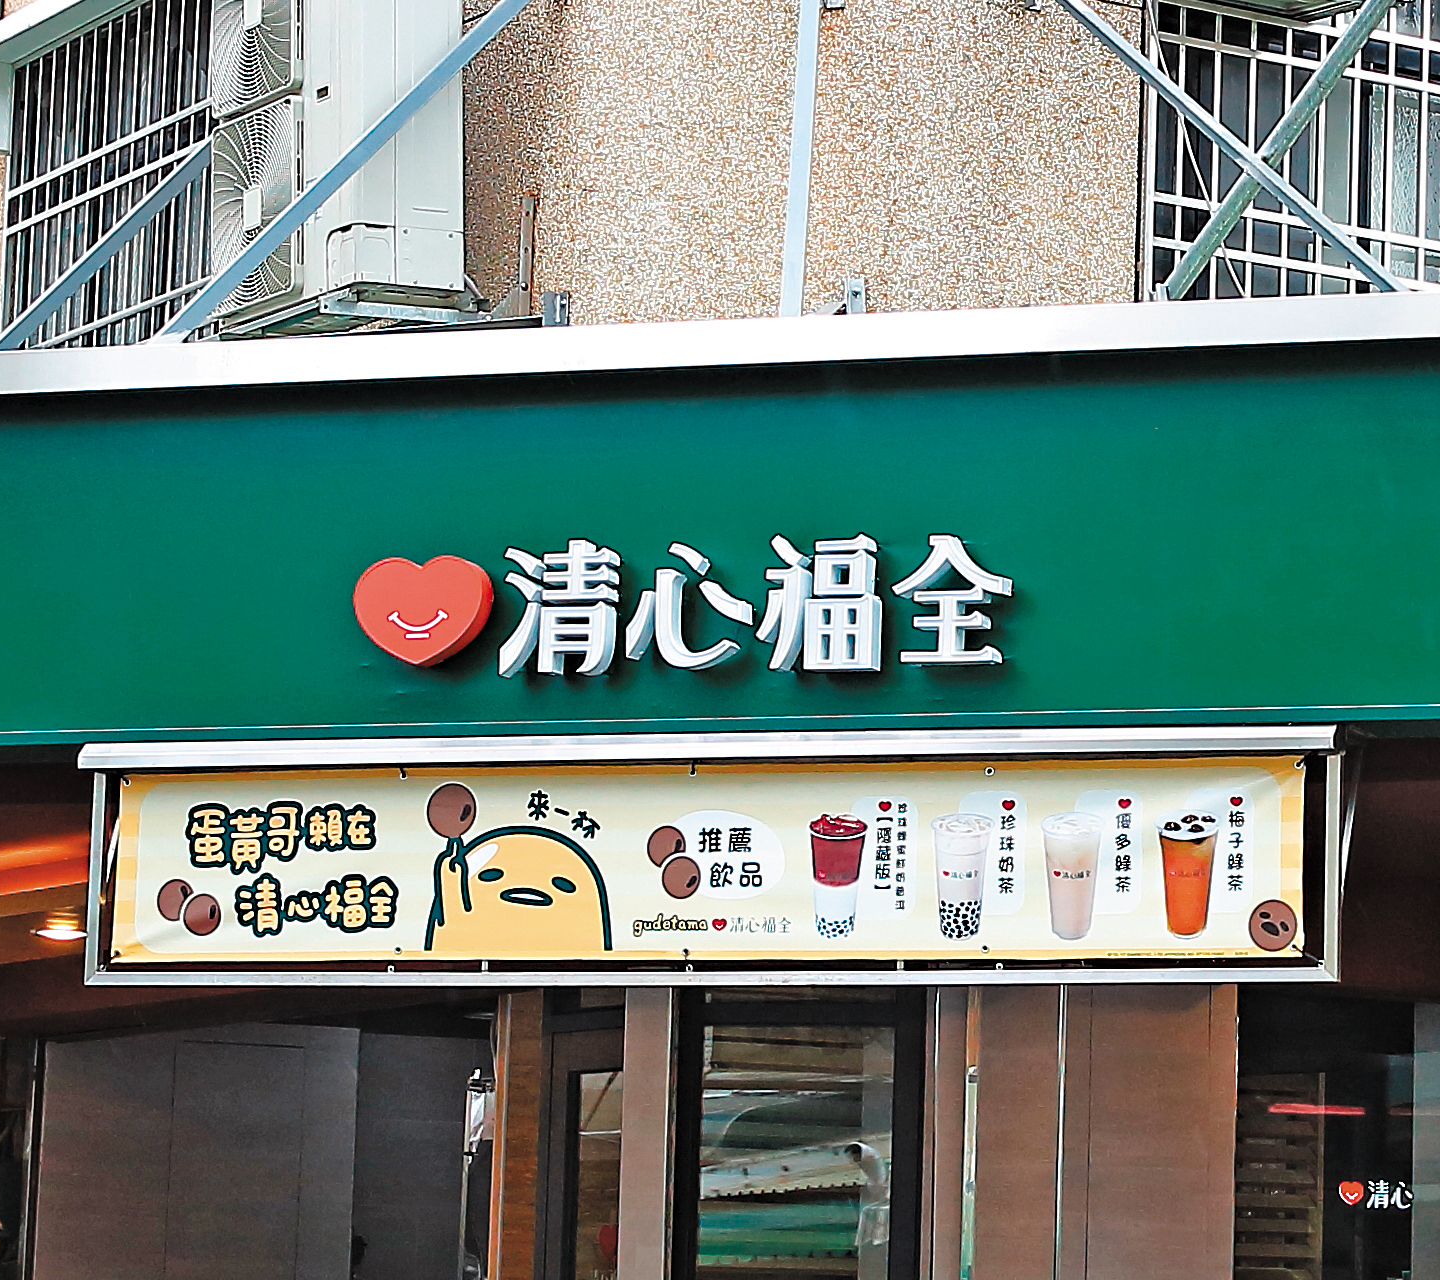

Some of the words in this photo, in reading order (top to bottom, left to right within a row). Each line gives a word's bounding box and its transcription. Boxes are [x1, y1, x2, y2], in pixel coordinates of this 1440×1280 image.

[499, 532, 1013, 678] 清心福全
[698, 827, 752, 853] 推薦
[998, 814, 1016, 894] 珍珠奶茶
[1115, 812, 1132, 892] 優多綠茶
[1228, 810, 1245, 891] 梅子綠茶
[710, 861, 763, 888] 飲品
[235, 875, 399, 937] 清心福全
[633, 914, 709, 937] gudetama
[730, 916, 792, 934] 清心福全
[1366, 1179, 1413, 1209] 清心
